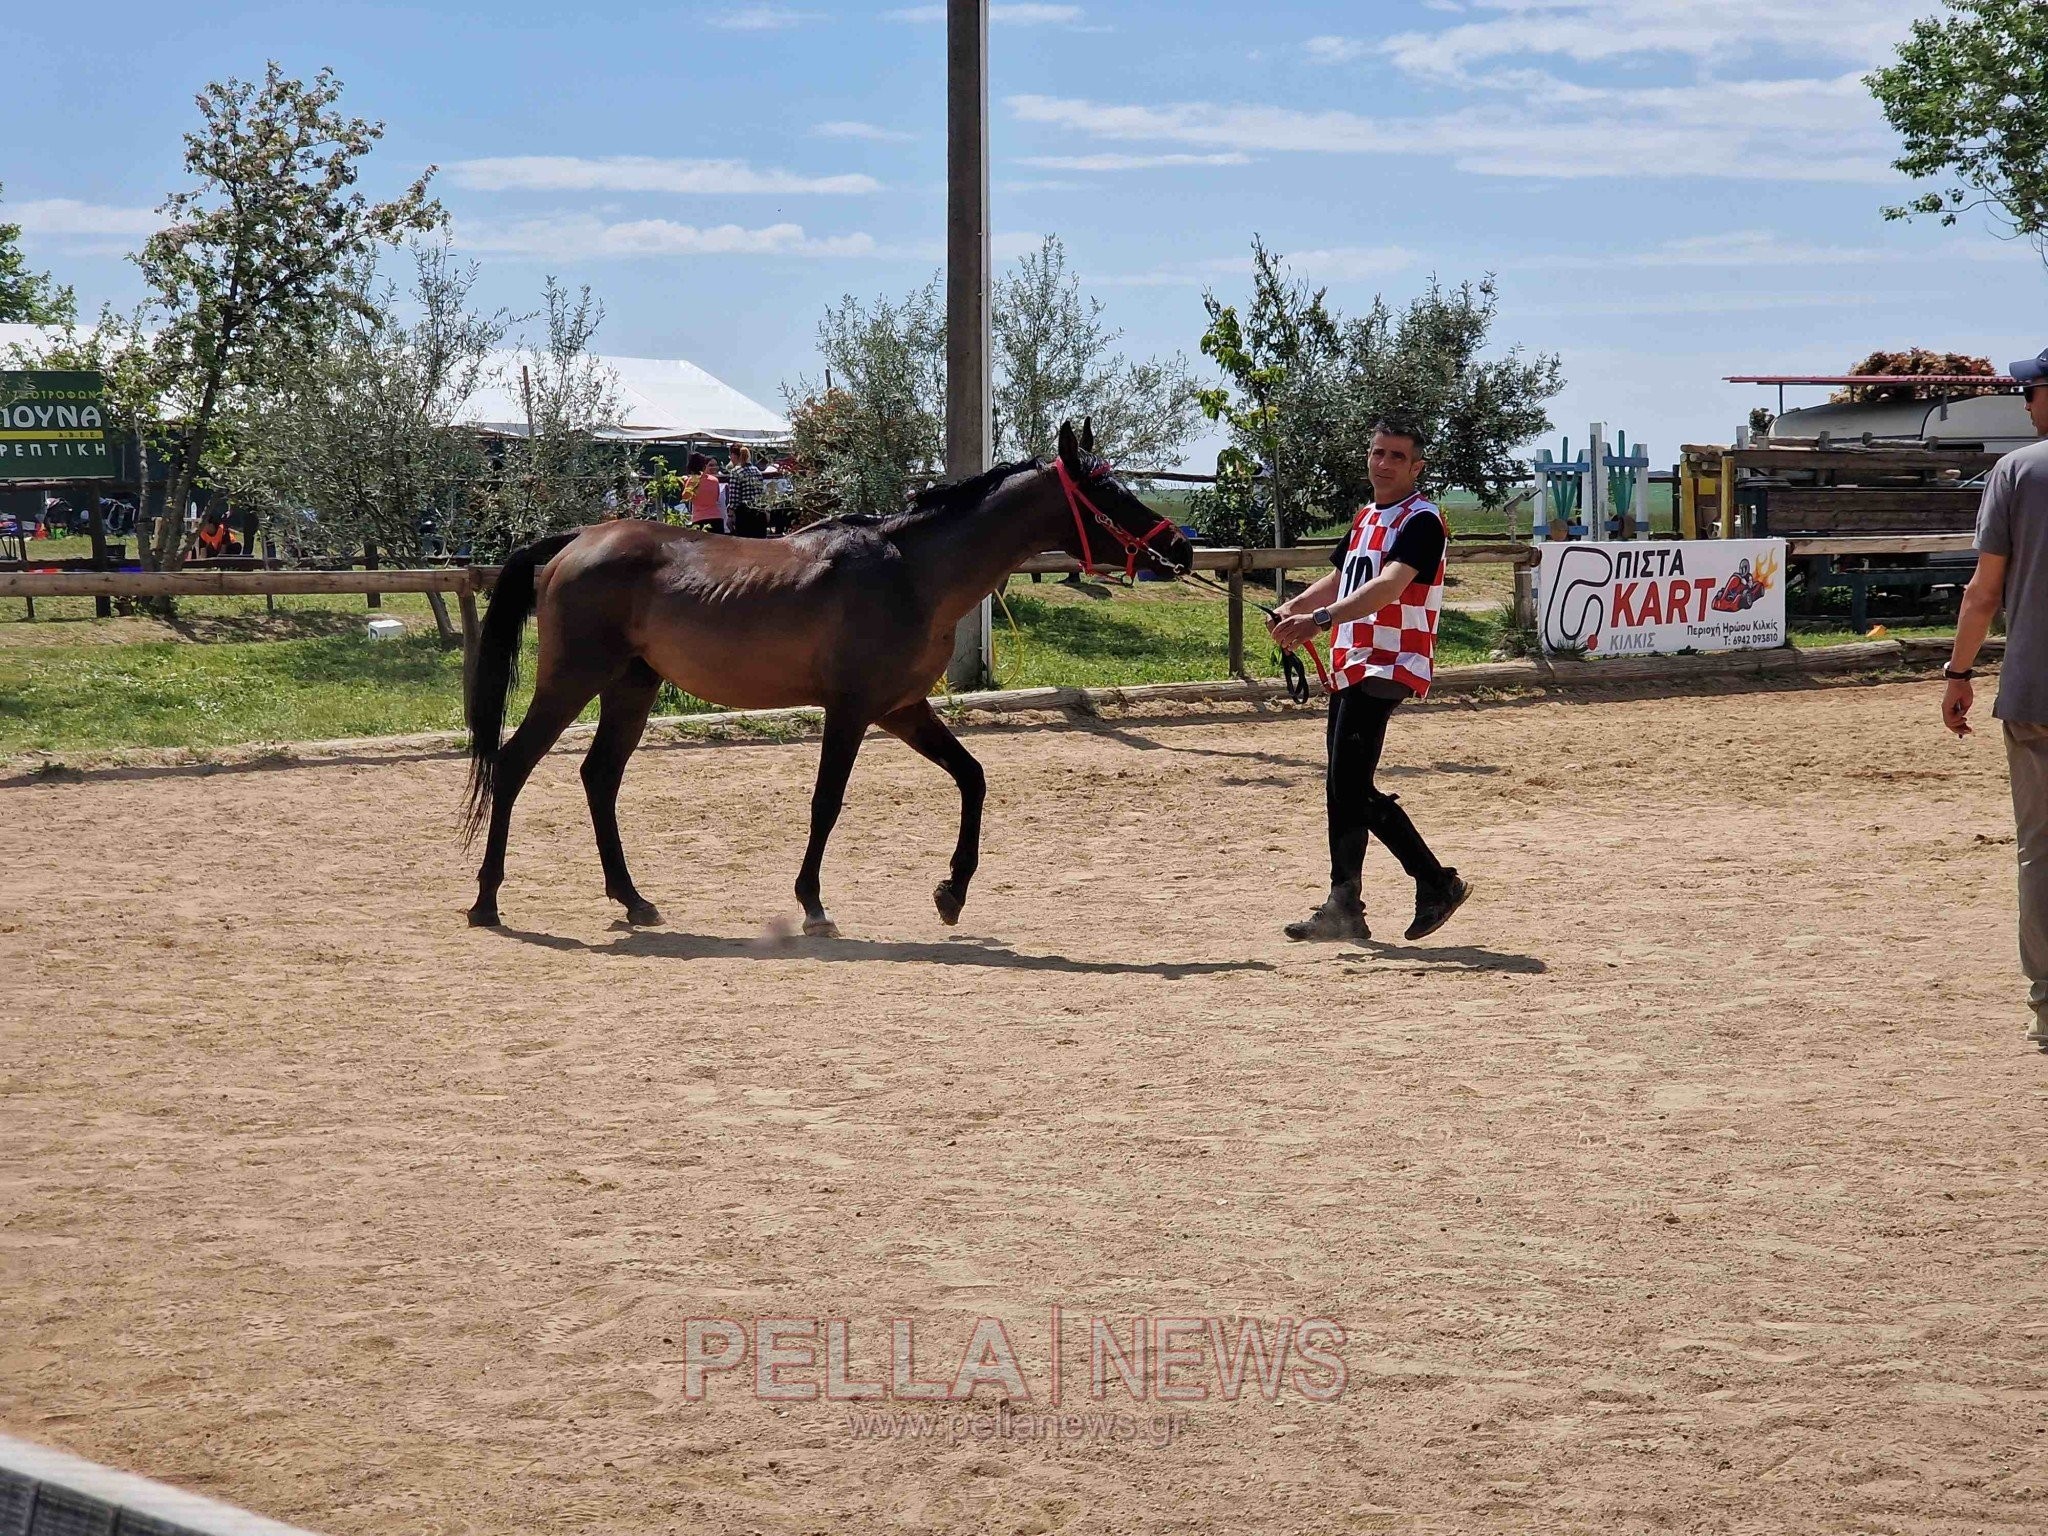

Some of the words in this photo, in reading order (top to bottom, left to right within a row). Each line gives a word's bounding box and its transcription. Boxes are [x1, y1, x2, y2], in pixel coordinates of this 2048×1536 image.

[1615, 549, 1684, 579] ΠΙΣΤΑ
[1610, 577, 1716, 628] KART
[1687, 622, 1721, 638] Περιοχή
[1722, 621, 1751, 635] Ηρώου
[1752, 618, 1778, 631] Κιλκίς
[1610, 632, 1656, 650] ΚΙΛΚΙΣ
[1733, 635, 1750, 645] 6942
[1752, 633, 1778, 644] 093810
